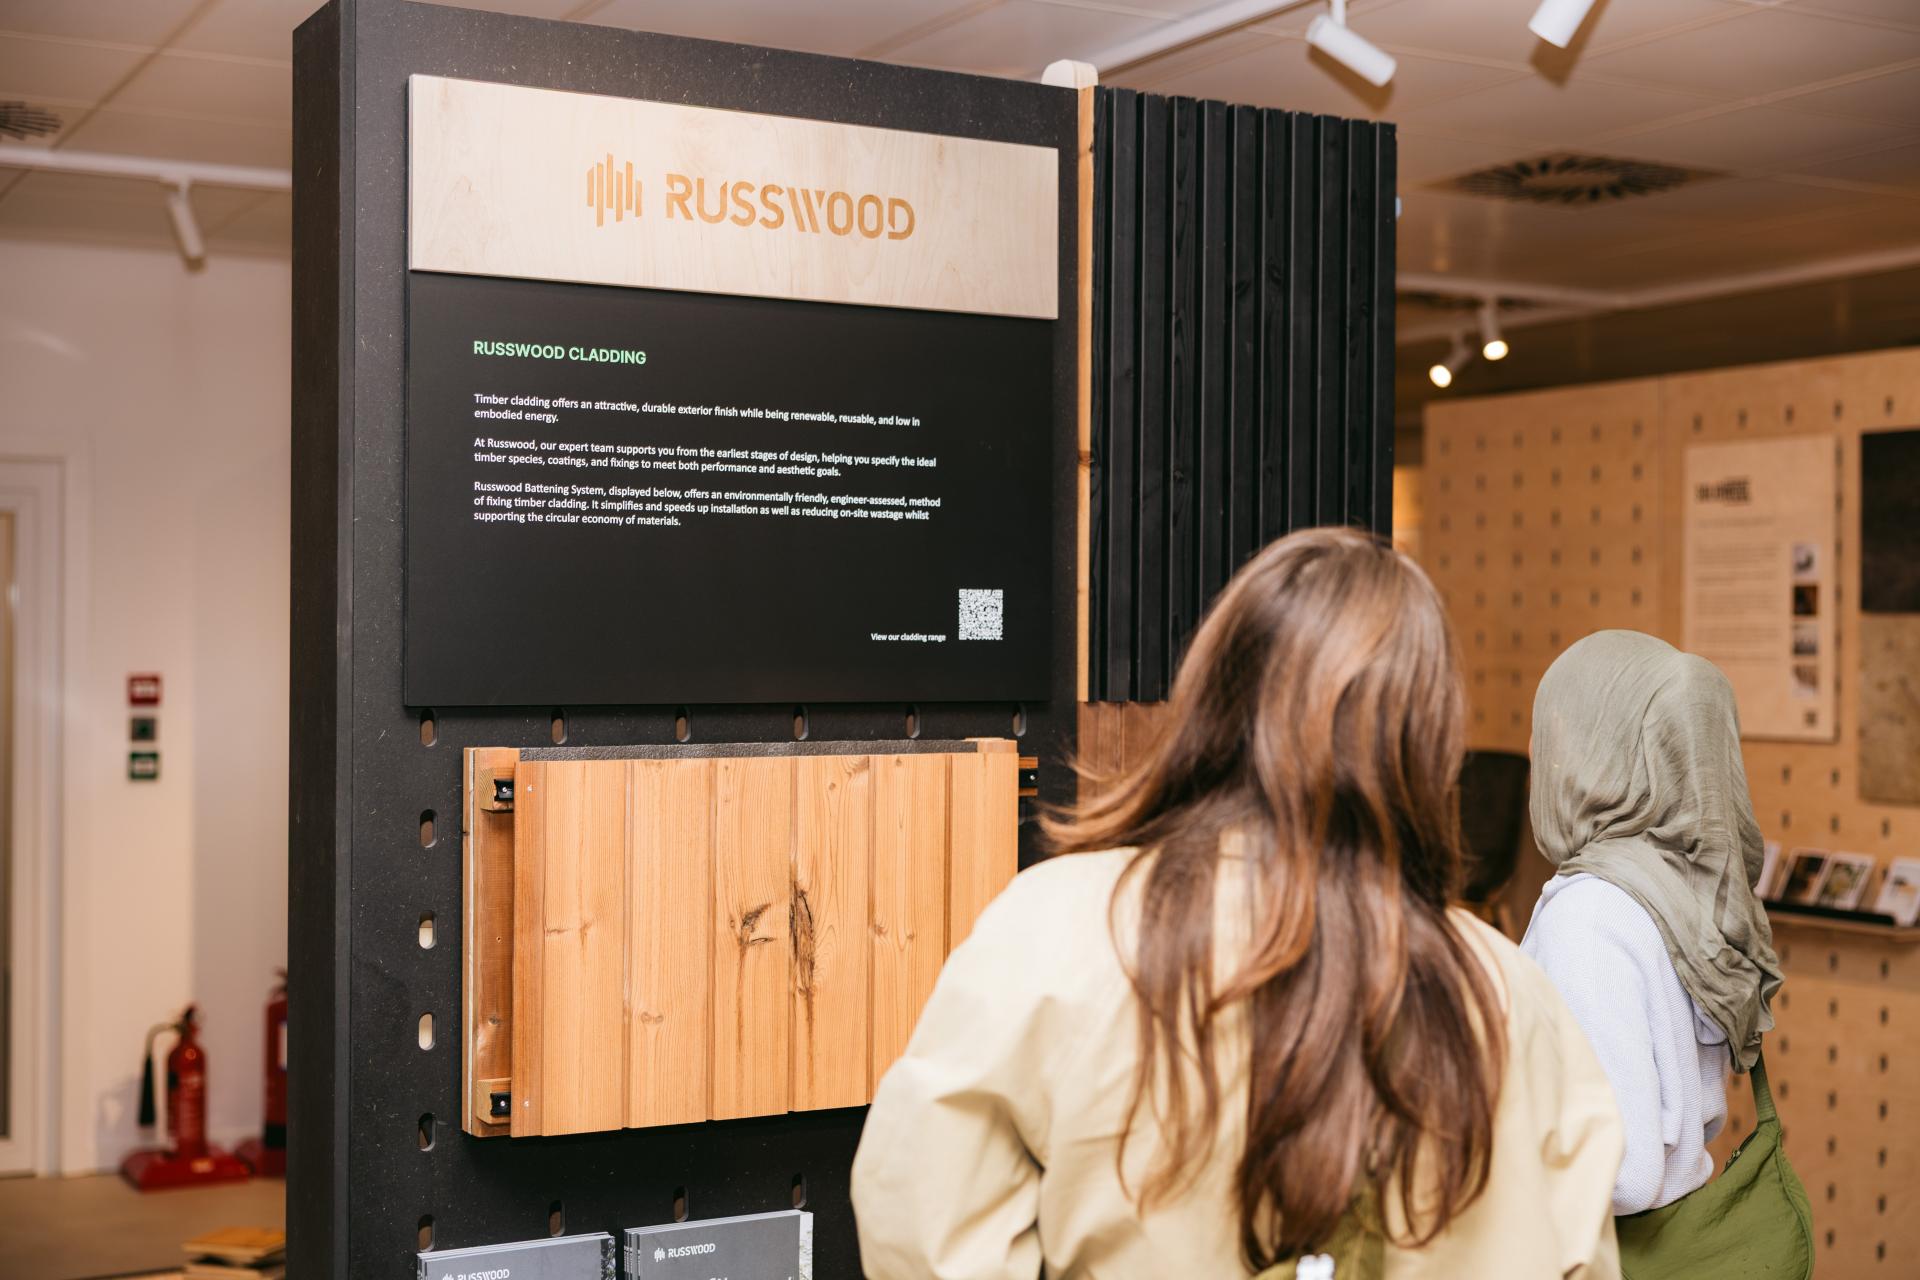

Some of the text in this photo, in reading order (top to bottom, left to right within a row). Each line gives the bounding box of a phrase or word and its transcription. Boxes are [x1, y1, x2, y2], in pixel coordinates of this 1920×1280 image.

[666, 173, 915, 240] RUSSWOOD
[474, 340, 646, 364] RUSSWOOD CLADDING
[473, 394, 920, 426] Timber cladding offers an attractive, durable exterior finish while being renewable, reusable, and low in
[474, 409, 559, 423] embodied energy.
[473, 437, 936, 467] At Russwood, our expert team supports you from the earliest stages of design, helping you specify the ideal
[474, 452, 841, 478] timber species, coatings, and fixings to meet both performance and aesthetic goals.
[474, 482, 941, 507] Russwood Battening System, displayed below, offers an environmentally friendly, engineer-assessed, method
[473, 512, 681, 526] supporting the circular economy of materials.
[474, 496, 929, 520] of fixing timber cladding. It simplifies and speeds up installation as well as reducing on-site wastage whilst
[870, 633, 888, 641] View
[900, 633, 928, 642] cladding
[928, 634, 946, 643] range
[668, 1243, 716, 1258] RUSSWOOD
